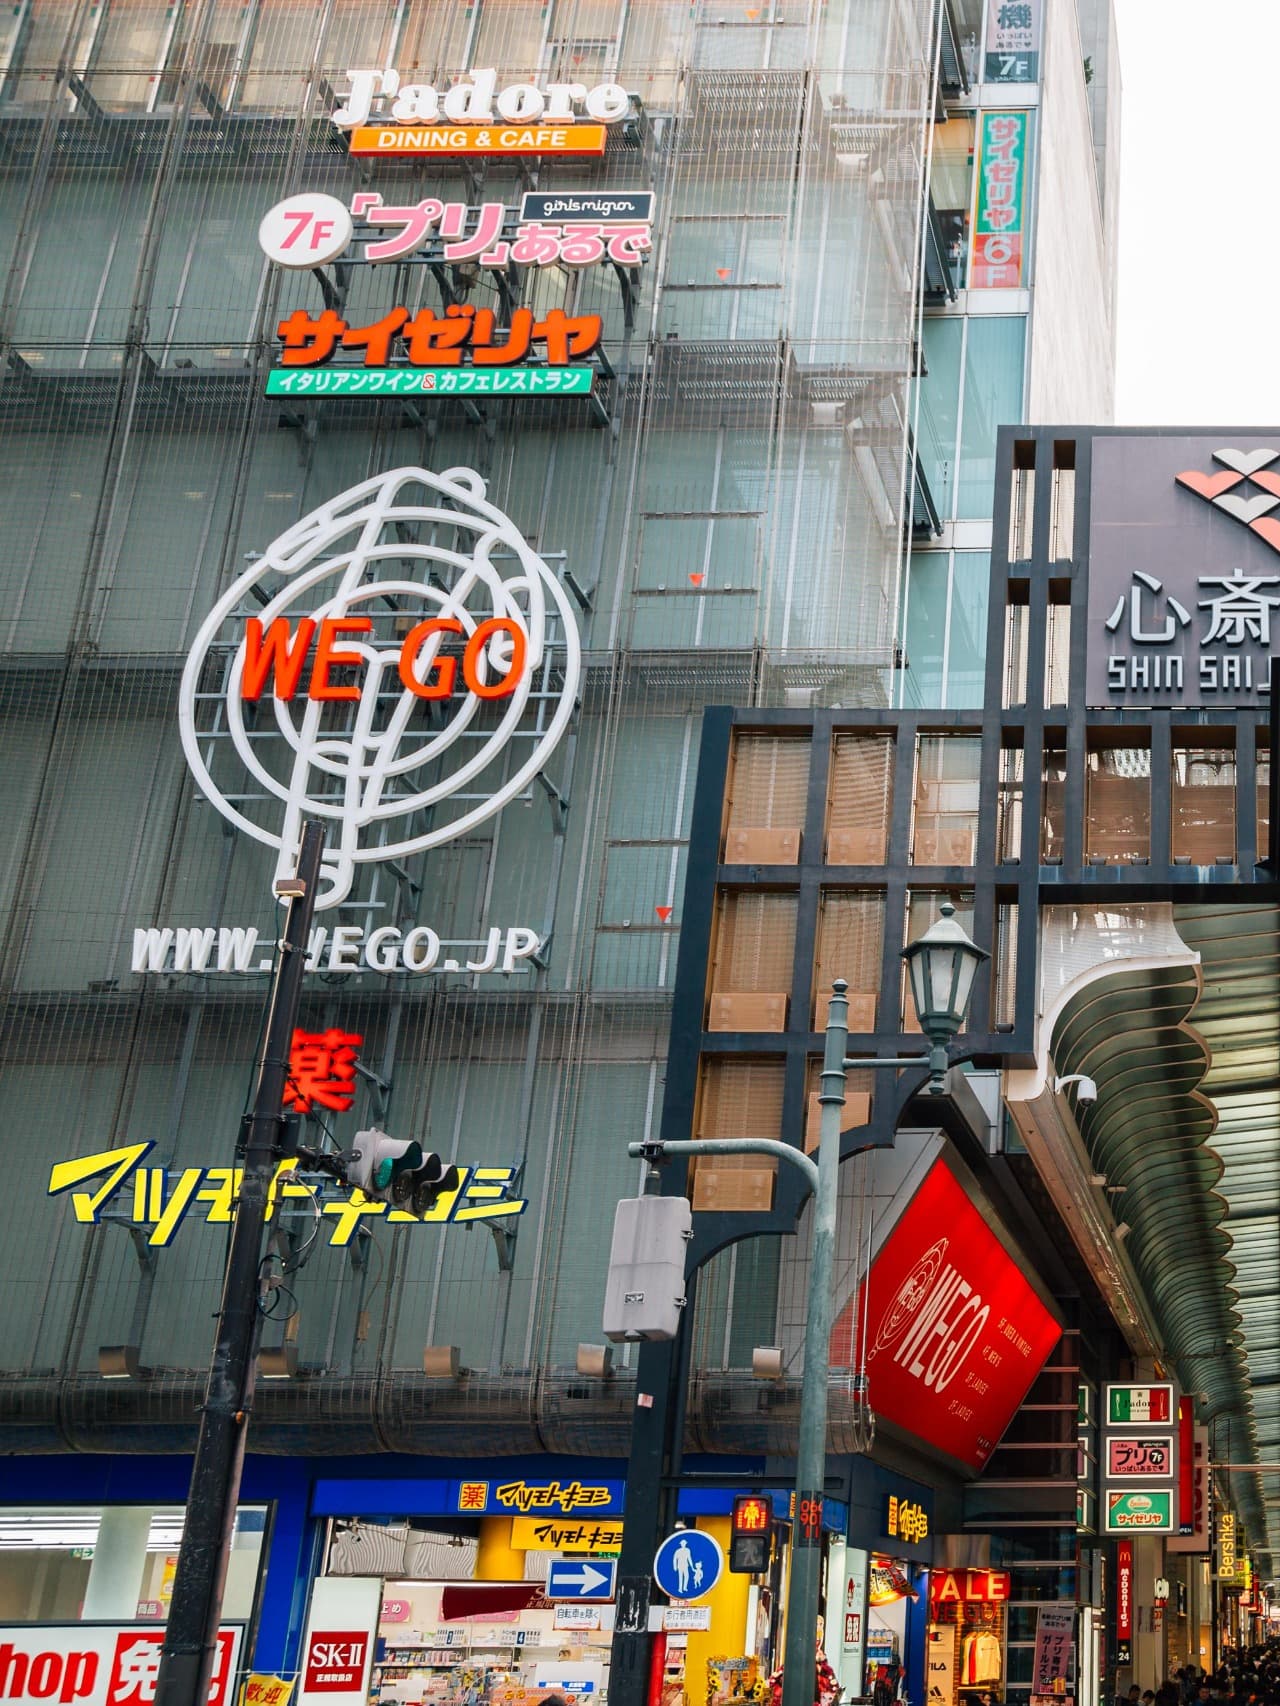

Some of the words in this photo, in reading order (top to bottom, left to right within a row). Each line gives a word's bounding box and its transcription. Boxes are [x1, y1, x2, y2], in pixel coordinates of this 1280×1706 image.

[999, 56, 1028, 75] 7F
[332, 69, 631, 127] J'adore
[377, 130, 469, 149] DINING
[474, 130, 492, 148] &
[499, 129, 567, 148] CAFE
[983, 115, 1024, 231] サイゼリヤ
[279, 211, 334, 251] 7F
[277, 305, 602, 366] サイゼリヤ
[279, 370, 582, 391] イタリアンワイン&カフェレストラン
[241, 617, 372, 701] WE
[400, 617, 527, 700] GO
[1108, 655, 1184, 690] SHIN
[283, 1028, 363, 1113] 薬
[893, 1264, 990, 1394] WEGO
[1115, 1448, 1147, 1466] プリ
[1151, 1452, 1163, 1463] 7F
[462, 1484, 485, 1508] 薬
[496, 1481, 612, 1512] マツモトキヨシ
[1116, 1513, 1163, 1526] サイゼリヤ
[1219, 1514, 1234, 1577] Bershka
[556, 1608, 599, 1619] 自転車を除く
[1120, 1568, 1129, 1628] McDonald's
[310, 1643, 363, 1668] SK-II
[929, 1662, 947, 1671] ILA
[1118, 1653, 1129, 1661] 24
